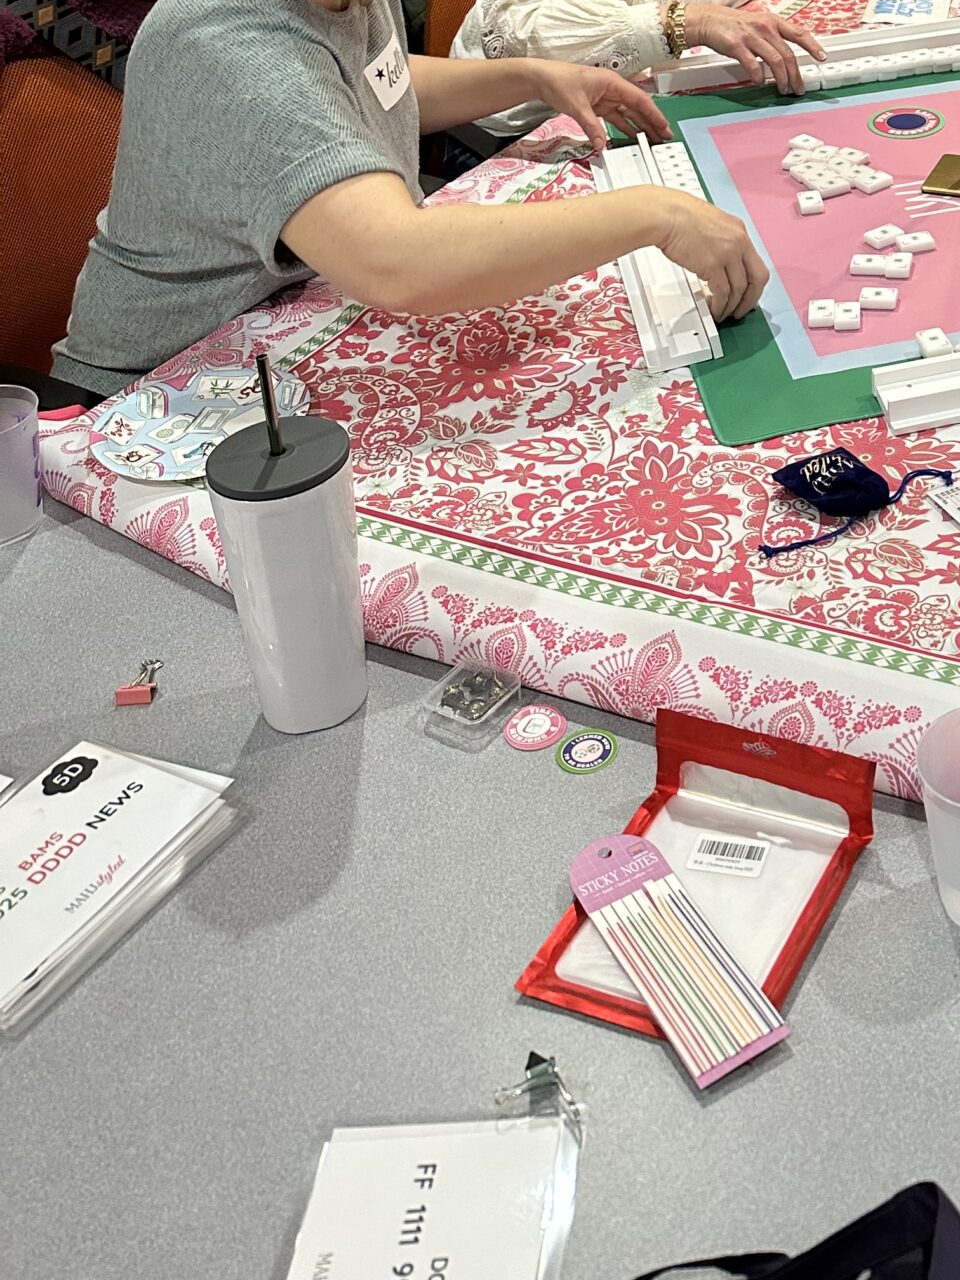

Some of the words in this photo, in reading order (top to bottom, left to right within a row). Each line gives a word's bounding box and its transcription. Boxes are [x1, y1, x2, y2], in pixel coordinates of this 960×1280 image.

[52, 762, 84, 787] 5D
[18, 831, 64, 871] BAMS
[27, 832, 87, 885] DDDD
[85, 781, 145, 830] NEWS
[578, 870, 619, 897] STICKY
[622, 851, 660, 876] NOTES
[413, 1163, 437, 1190] FF
[398, 1204, 427, 1246] 1111
